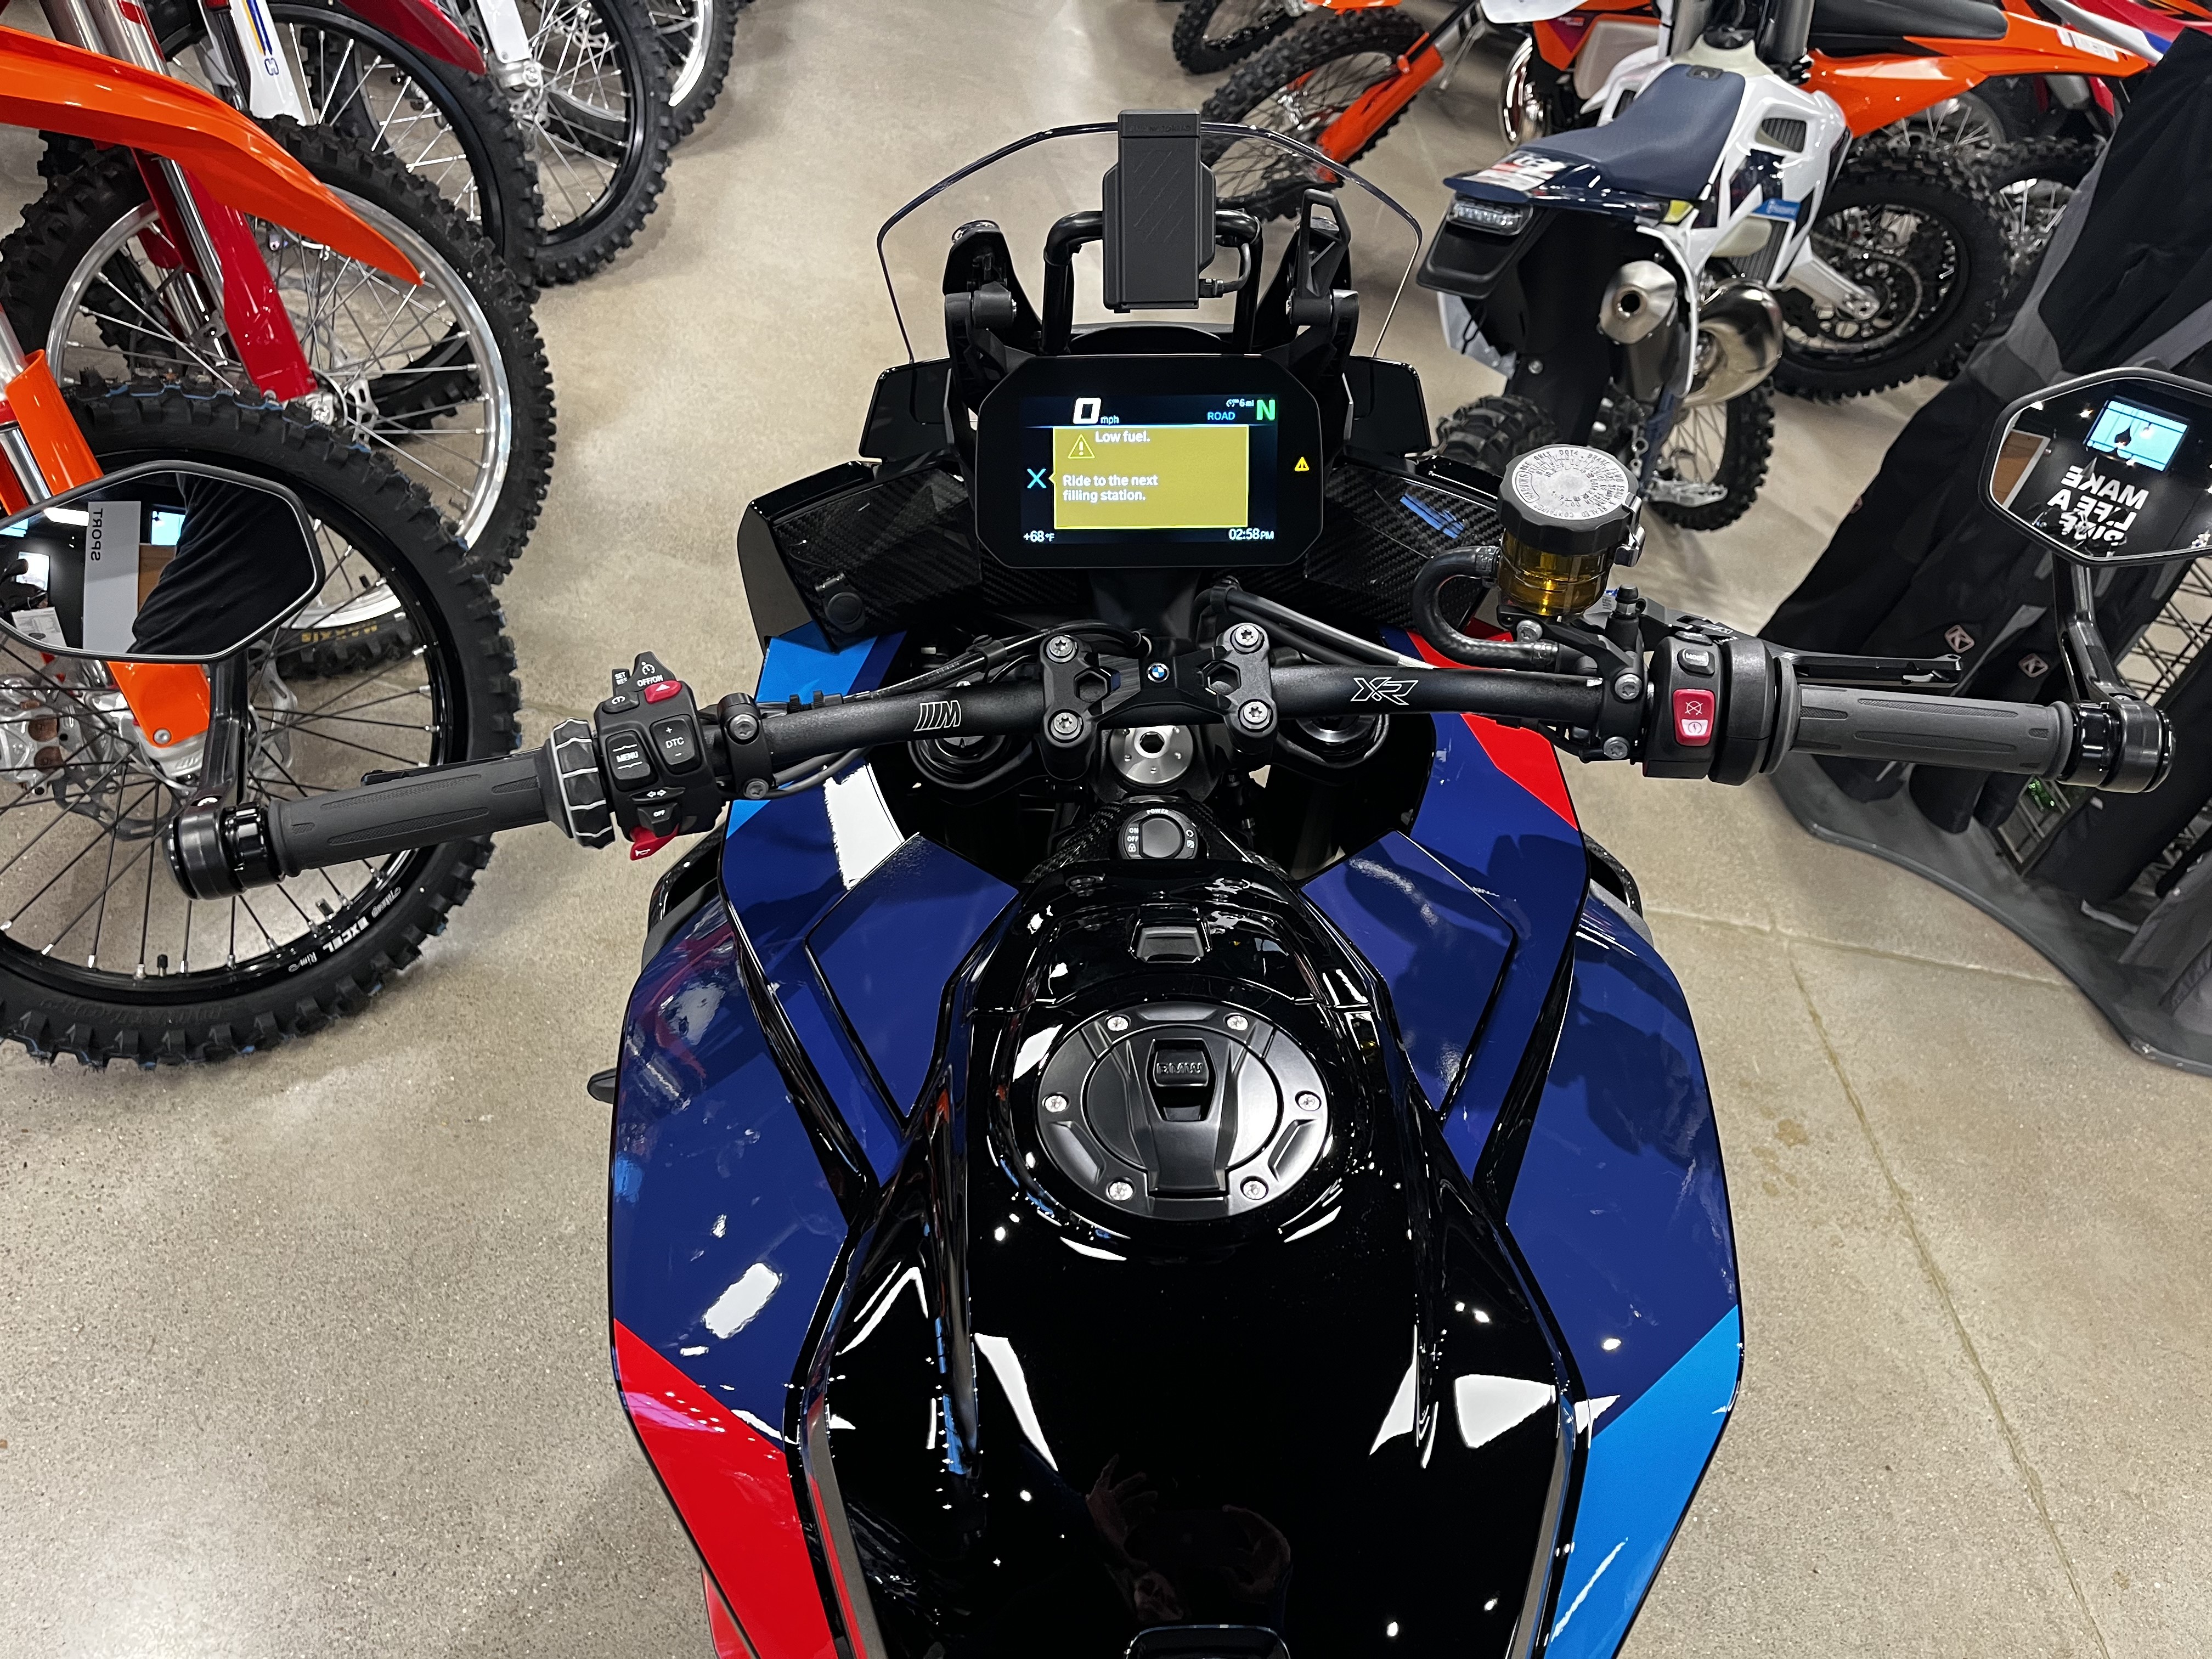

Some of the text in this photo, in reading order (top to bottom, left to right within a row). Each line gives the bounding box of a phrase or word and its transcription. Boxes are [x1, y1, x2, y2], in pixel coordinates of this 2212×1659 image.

[1207, 411, 1235, 421] ROAD
[1256, 399, 1276, 421] N
[1100, 415, 1120, 425] mph
[1095, 430, 1150, 442] Low fuel.
[1063, 474, 1159, 487] Ride to the next
[1063, 489, 1146, 503] filling station.
[614, 672, 627, 680] SET
[636, 674, 664, 687] OFF/ON
[1350, 676, 1419, 706] XR
[665, 736, 685, 749] DTC
[616, 751, 639, 763] MENU
[322, 916, 370, 953] EXCEL
[1156, 1062, 1203, 1074] BMW
